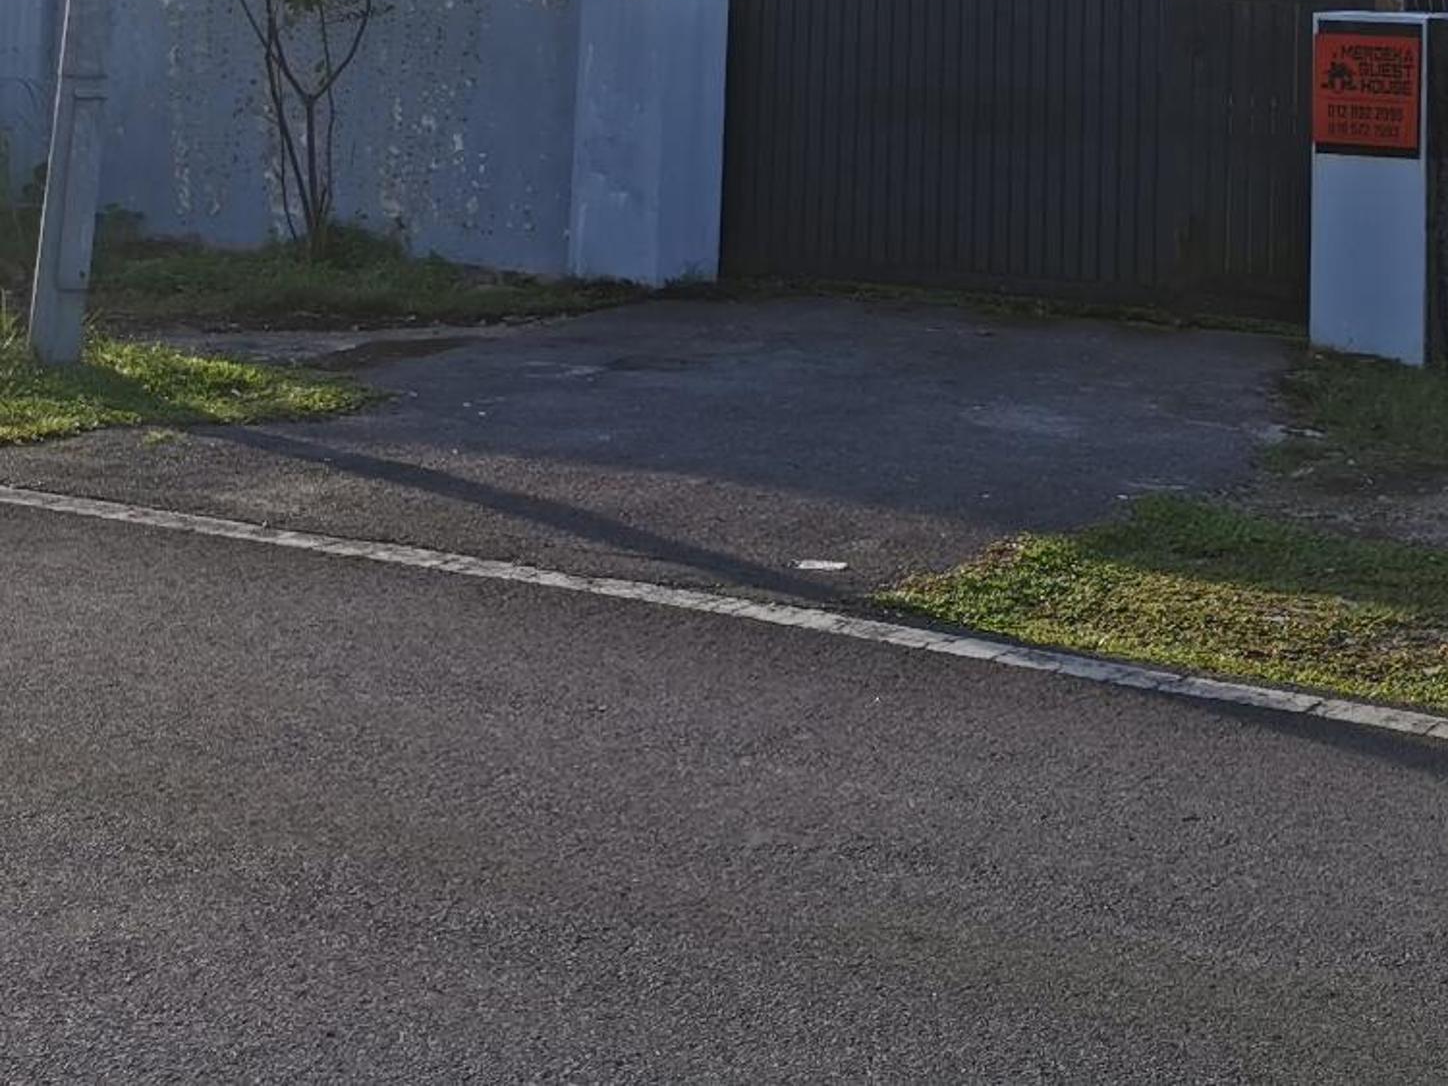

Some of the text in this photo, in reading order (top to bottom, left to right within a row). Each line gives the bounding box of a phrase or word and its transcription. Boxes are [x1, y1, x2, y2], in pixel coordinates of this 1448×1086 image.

[1342, 45, 1414, 62] MERDEKA
[1359, 63, 1414, 79] GUEST
[1359, 80, 1412, 97] HOUSE
